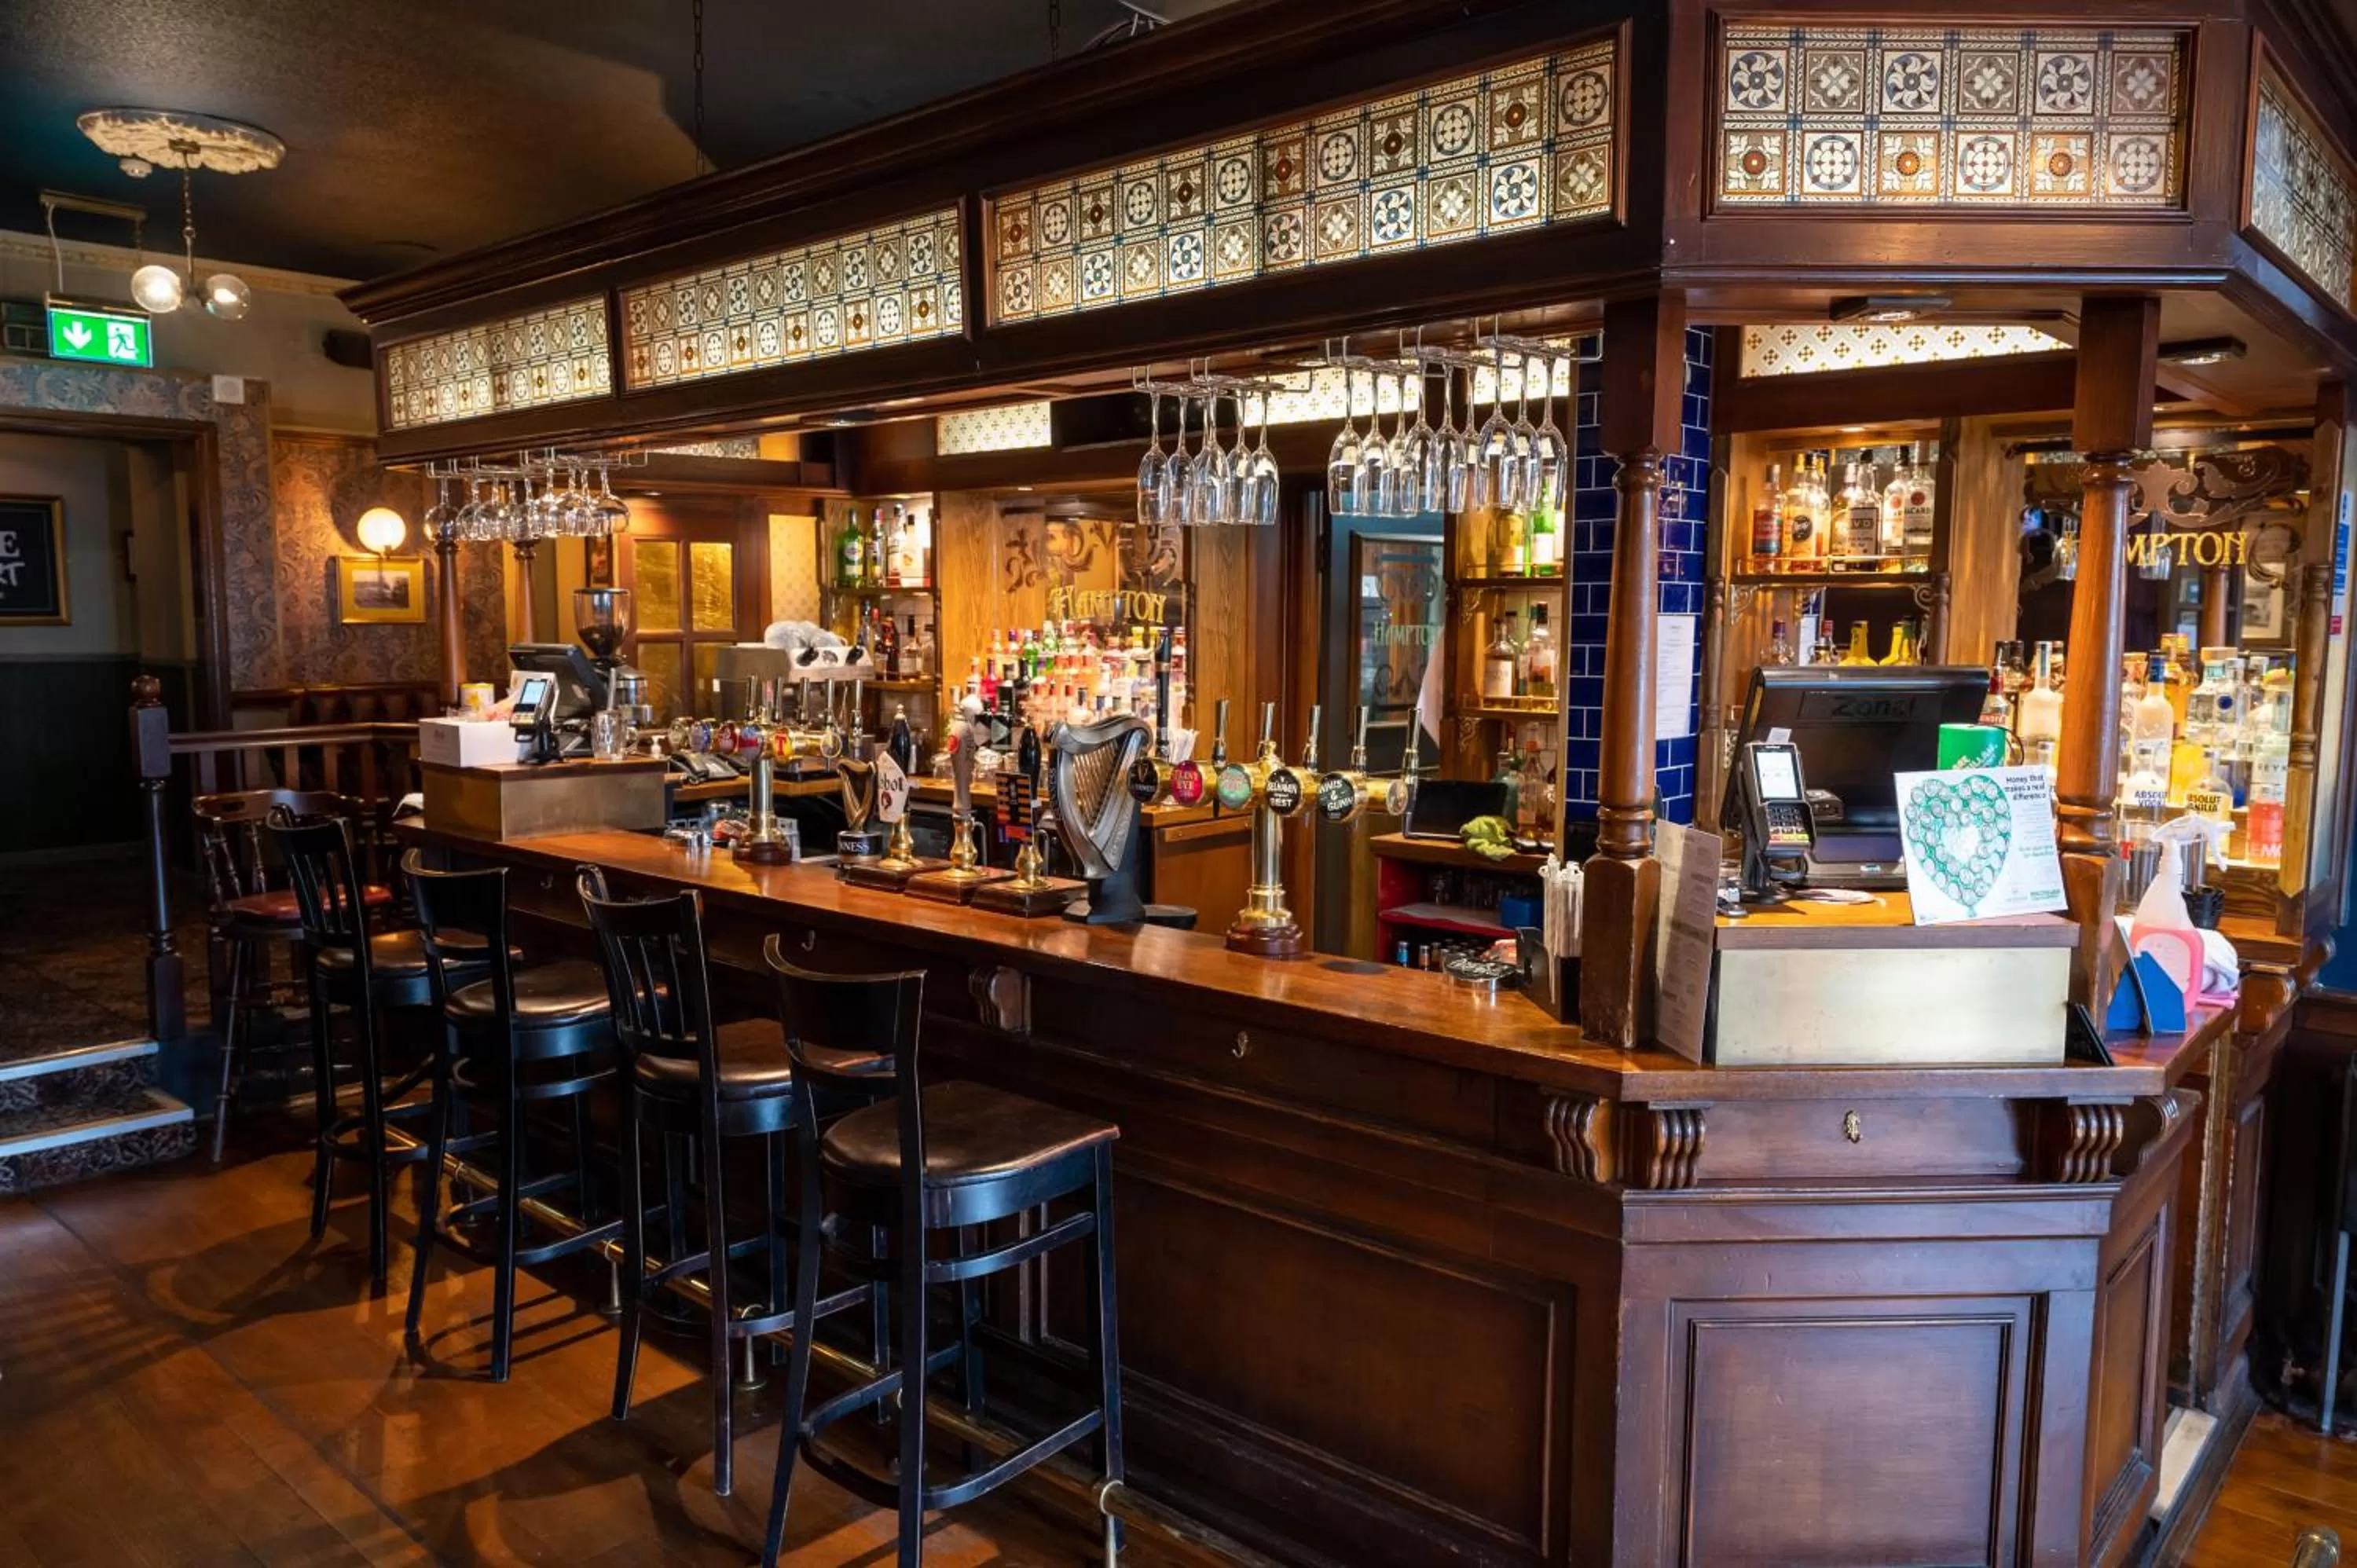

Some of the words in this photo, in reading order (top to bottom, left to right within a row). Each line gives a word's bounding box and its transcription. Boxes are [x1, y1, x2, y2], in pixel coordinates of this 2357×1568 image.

[2127, 529, 2248, 566] MPTON
[1049, 584, 1167, 624] HAMTON
[1374, 621, 1444, 647] HAMPTO
[1832, 695, 1915, 716] Zonal
[775, 733, 785, 756] T
[1270, 797, 1292, 807] BEST
